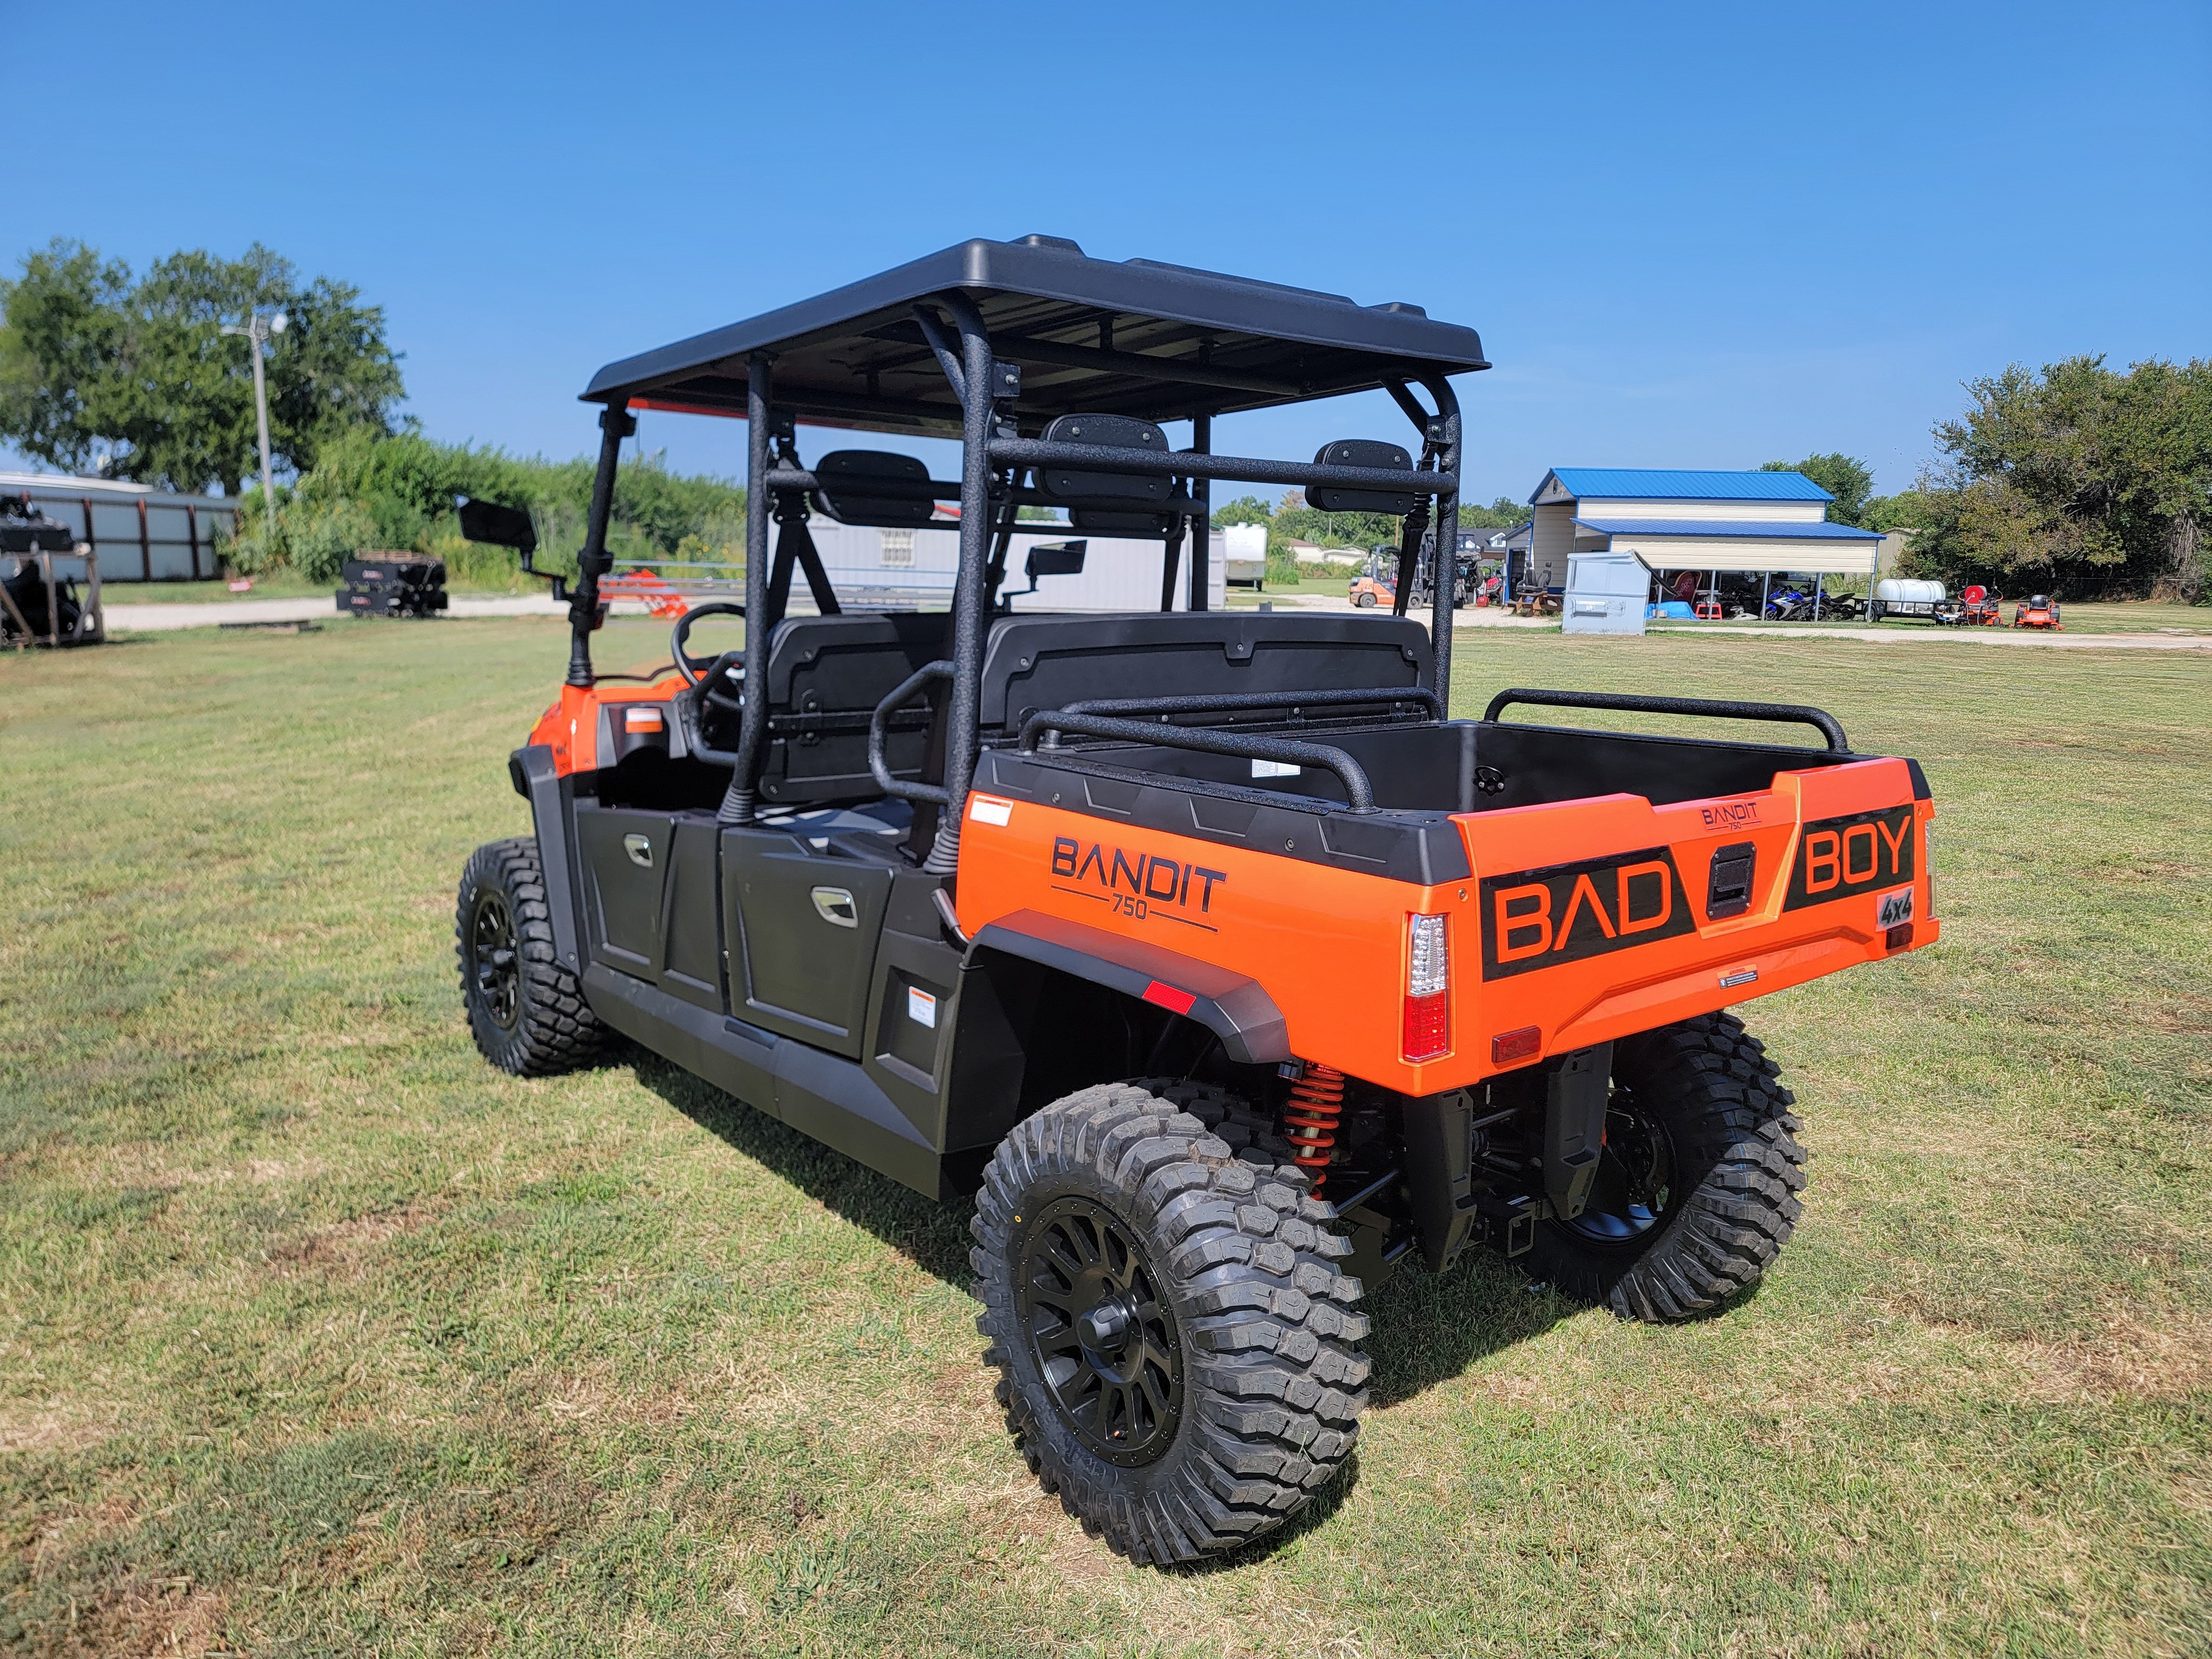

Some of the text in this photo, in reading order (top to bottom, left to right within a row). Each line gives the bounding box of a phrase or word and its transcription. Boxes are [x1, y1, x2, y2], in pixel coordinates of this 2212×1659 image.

[1701, 802, 1757, 825] BANDIT
[1728, 821, 1741, 830] 750
[1052, 836, 1227, 913] BANDIT
[1495, 815, 1912, 964] BAD BOY
[1112, 893, 1148, 920] 750
